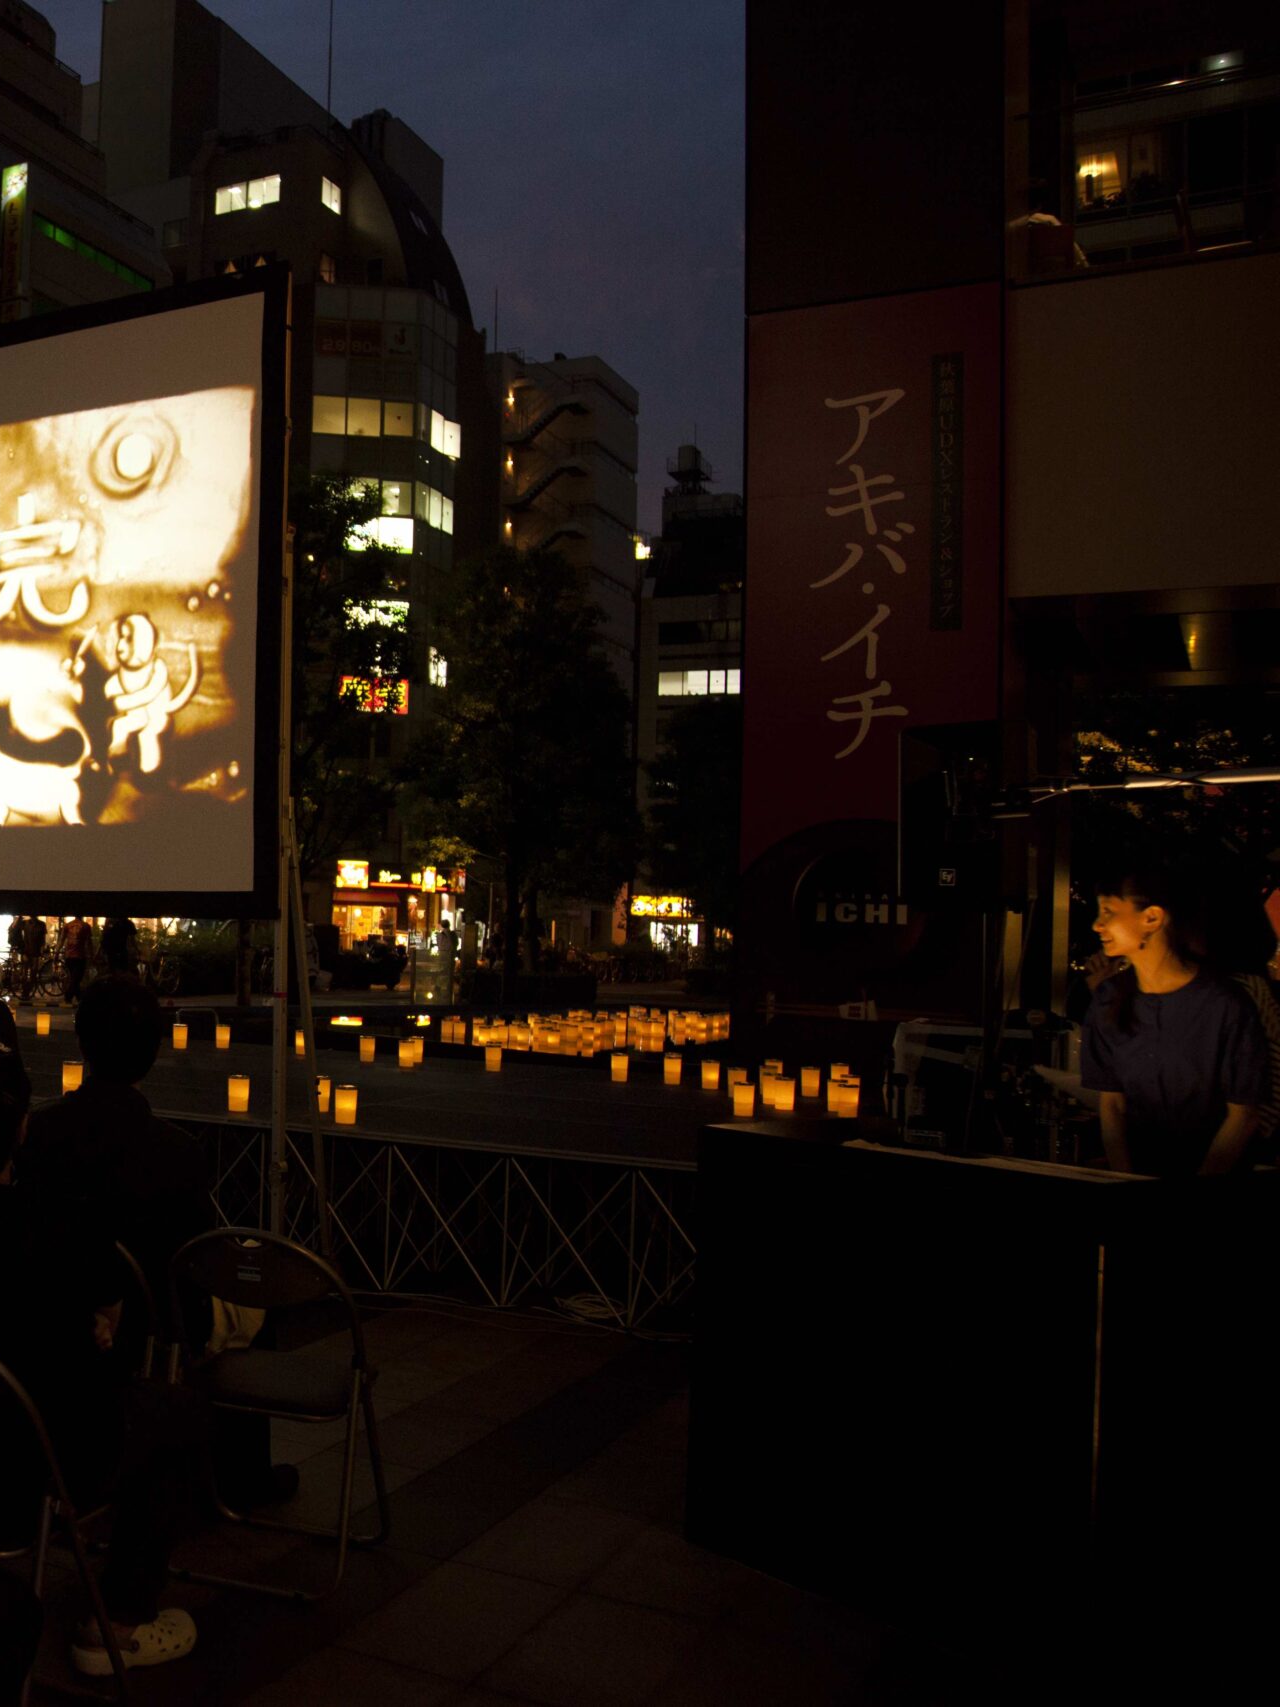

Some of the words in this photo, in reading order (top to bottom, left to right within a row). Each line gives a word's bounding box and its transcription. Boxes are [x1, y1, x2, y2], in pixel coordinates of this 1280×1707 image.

[809, 387, 916, 760] アキバ・イチ
[815, 901, 909, 926] ICHI
